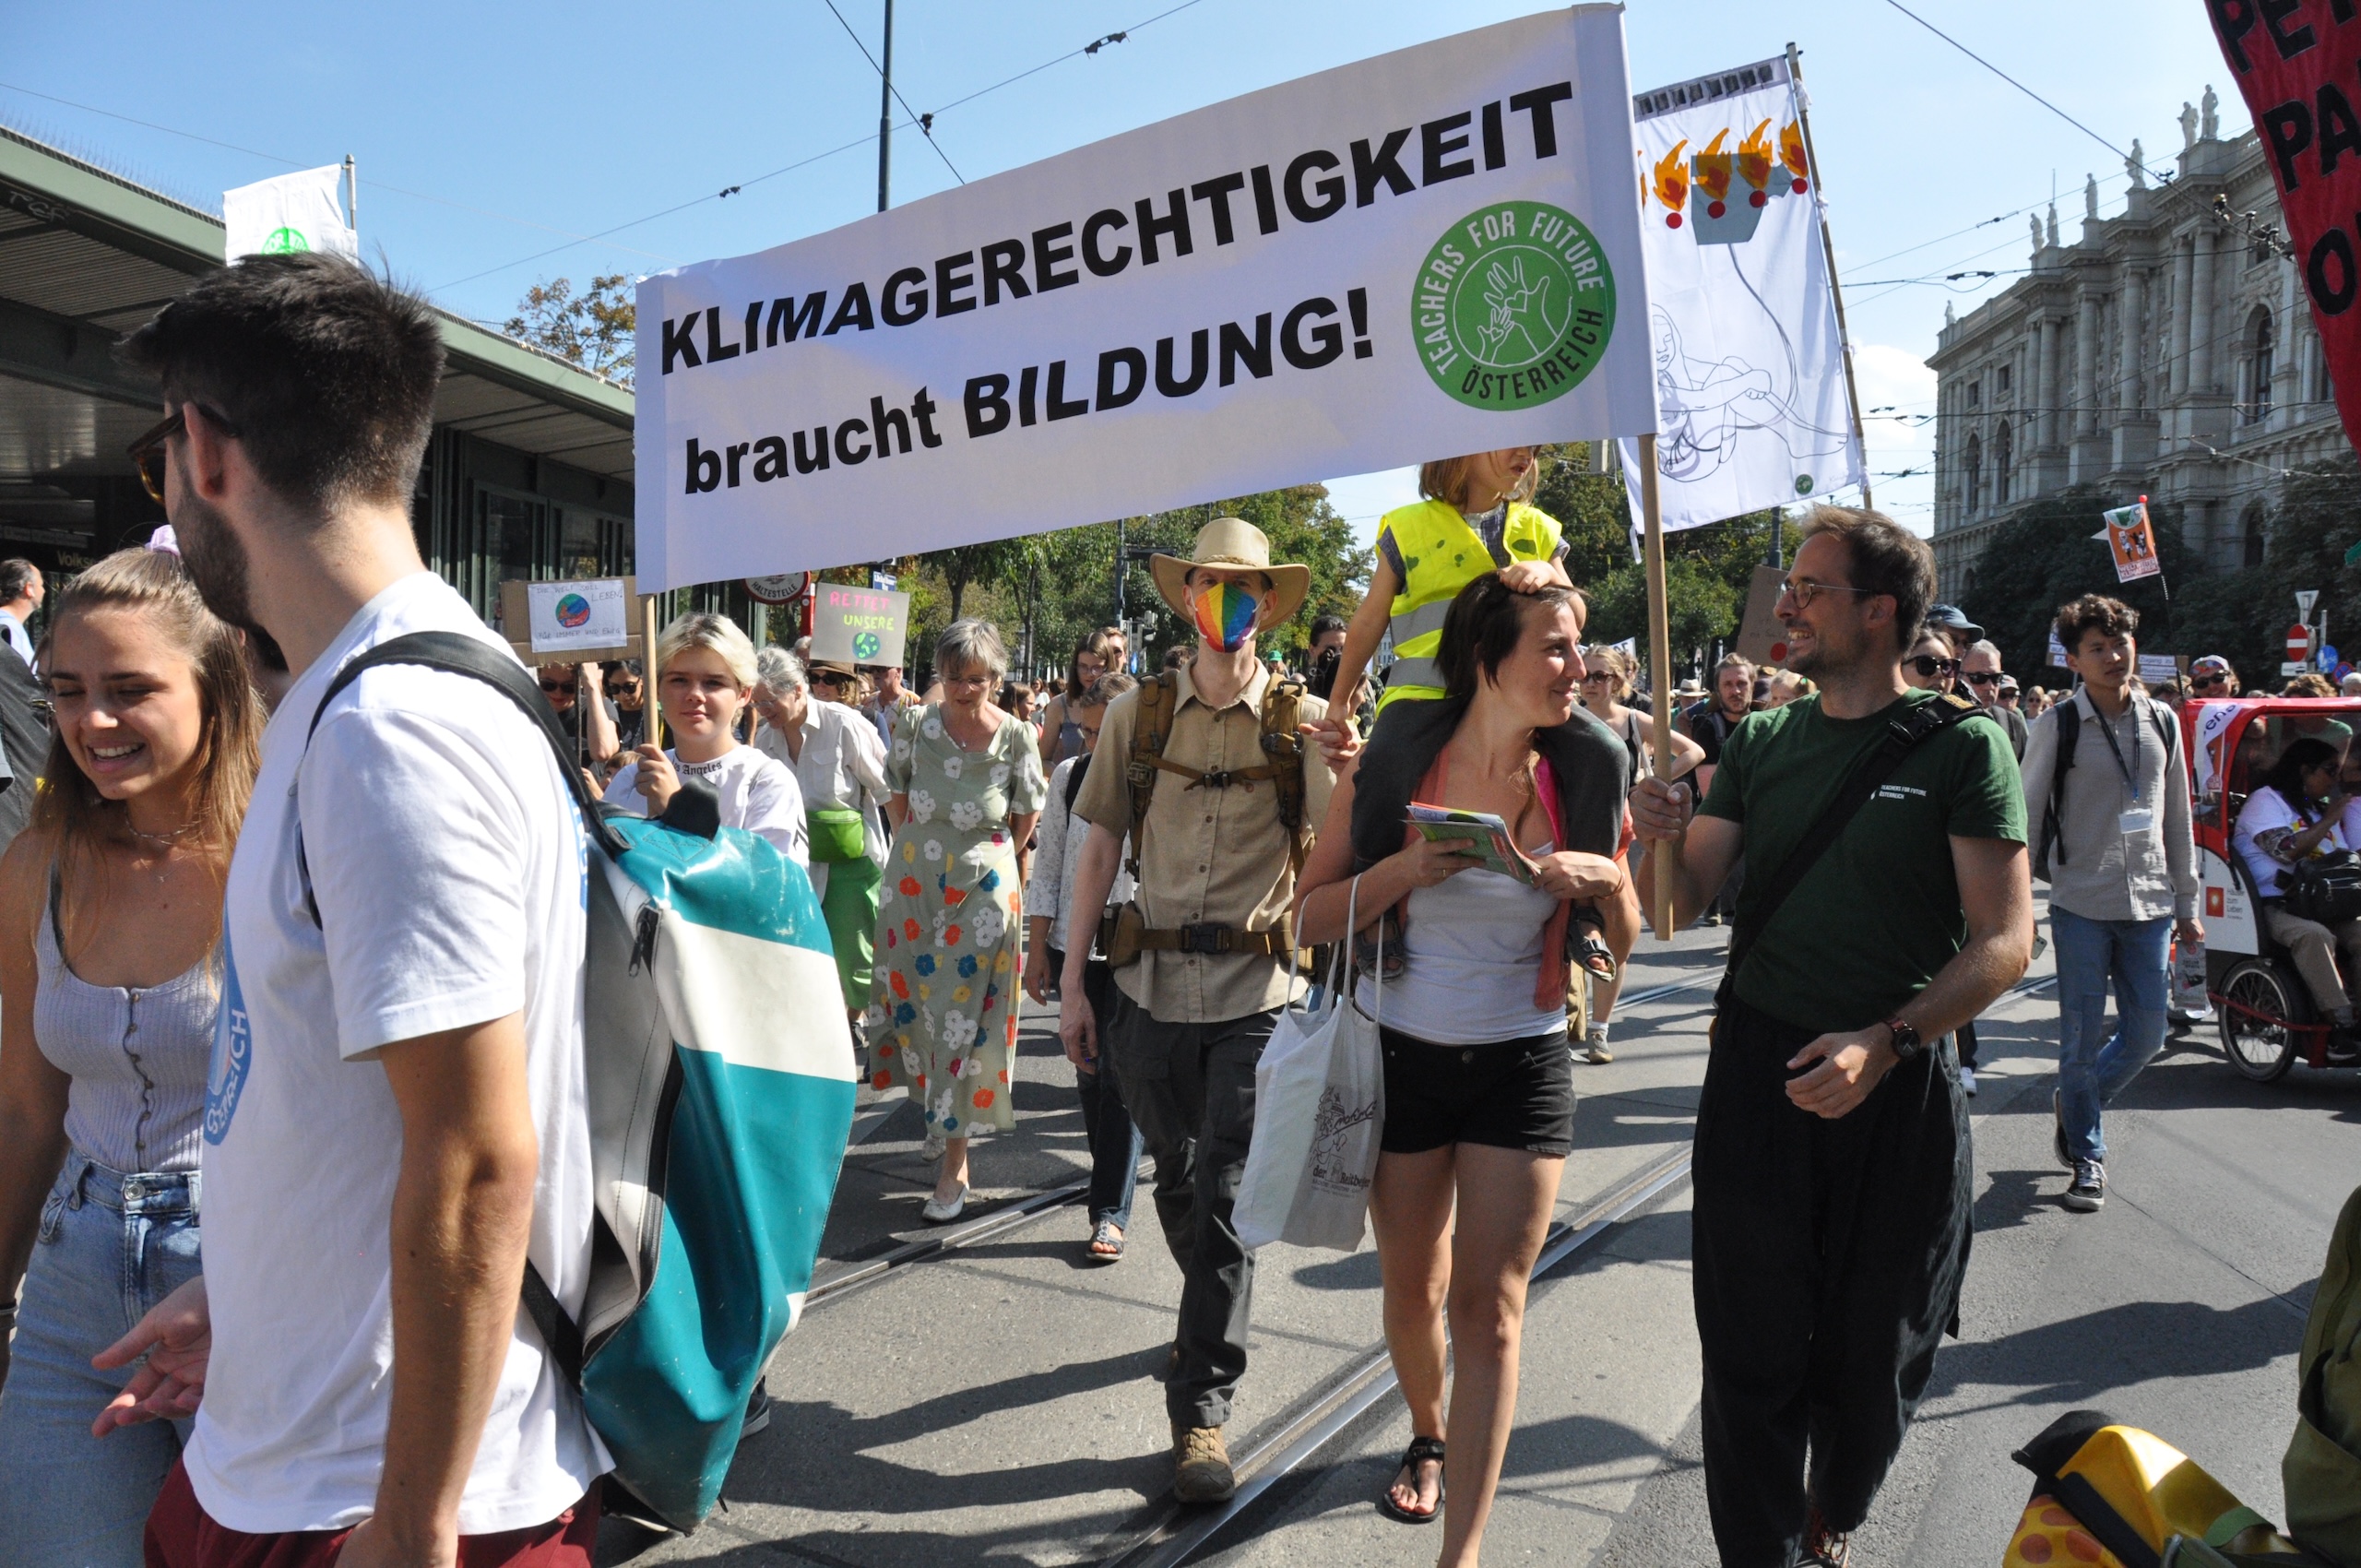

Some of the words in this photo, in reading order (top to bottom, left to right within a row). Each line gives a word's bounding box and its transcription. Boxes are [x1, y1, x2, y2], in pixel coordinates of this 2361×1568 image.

[2261, 57, 2361, 196] PA
[661, 79, 1573, 377] KLIMAGERECHTIGKEIT
[1419, 243, 1465, 376] TEACHERS
[1466, 209, 1516, 249] FOR
[1528, 210, 1605, 292] FUTURE
[2307, 211, 2361, 317] O
[1461, 308, 1604, 401] ÖSTERREICH
[684, 385, 943, 496] braucht
[962, 286, 1374, 440] BILDUNG!
[751, 581, 798, 599] HALTESTELLE
[830, 590, 890, 612] RETTET
[556, 629, 581, 639] IMMER
[844, 613, 896, 632] UNSERE
[682, 760, 723, 776] Angeles
[1312, 1164, 1327, 1179] der
